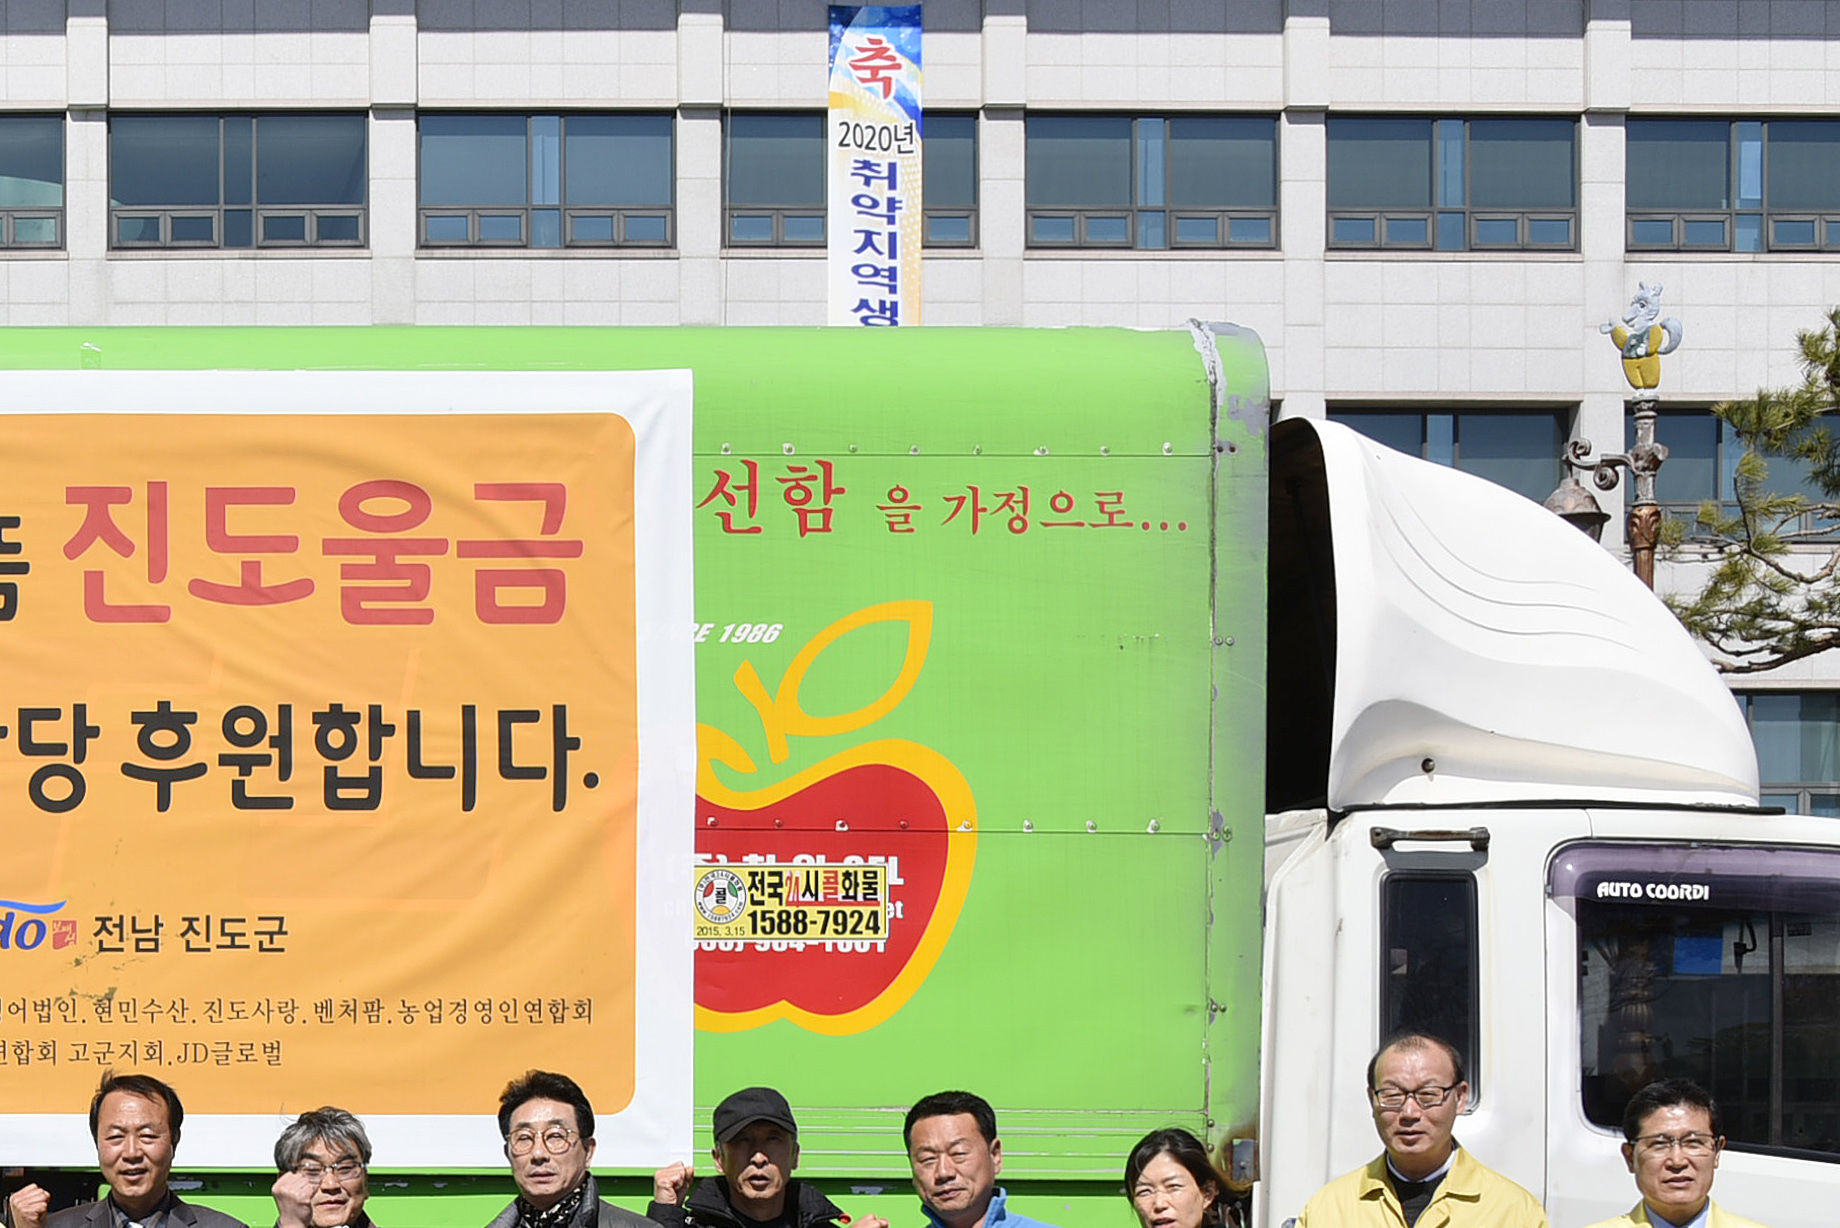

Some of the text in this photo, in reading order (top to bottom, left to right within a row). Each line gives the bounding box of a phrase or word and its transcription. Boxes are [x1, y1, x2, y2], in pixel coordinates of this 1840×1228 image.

[848, 36, 903, 100] 축
[837, 120, 916, 155] 2020년
[695, 458, 847, 539] 선함
[875, 483, 924, 534] 을
[62, 478, 584, 626] 진도울금
[718, 622, 784, 644] 1986
[120, 700, 599, 813] 후원합니다.
[1597, 882, 1709, 900] AUTO COORDI
[93, 914, 288, 953] 전남 진도군
[747, 909, 881, 935] 1588-7924
